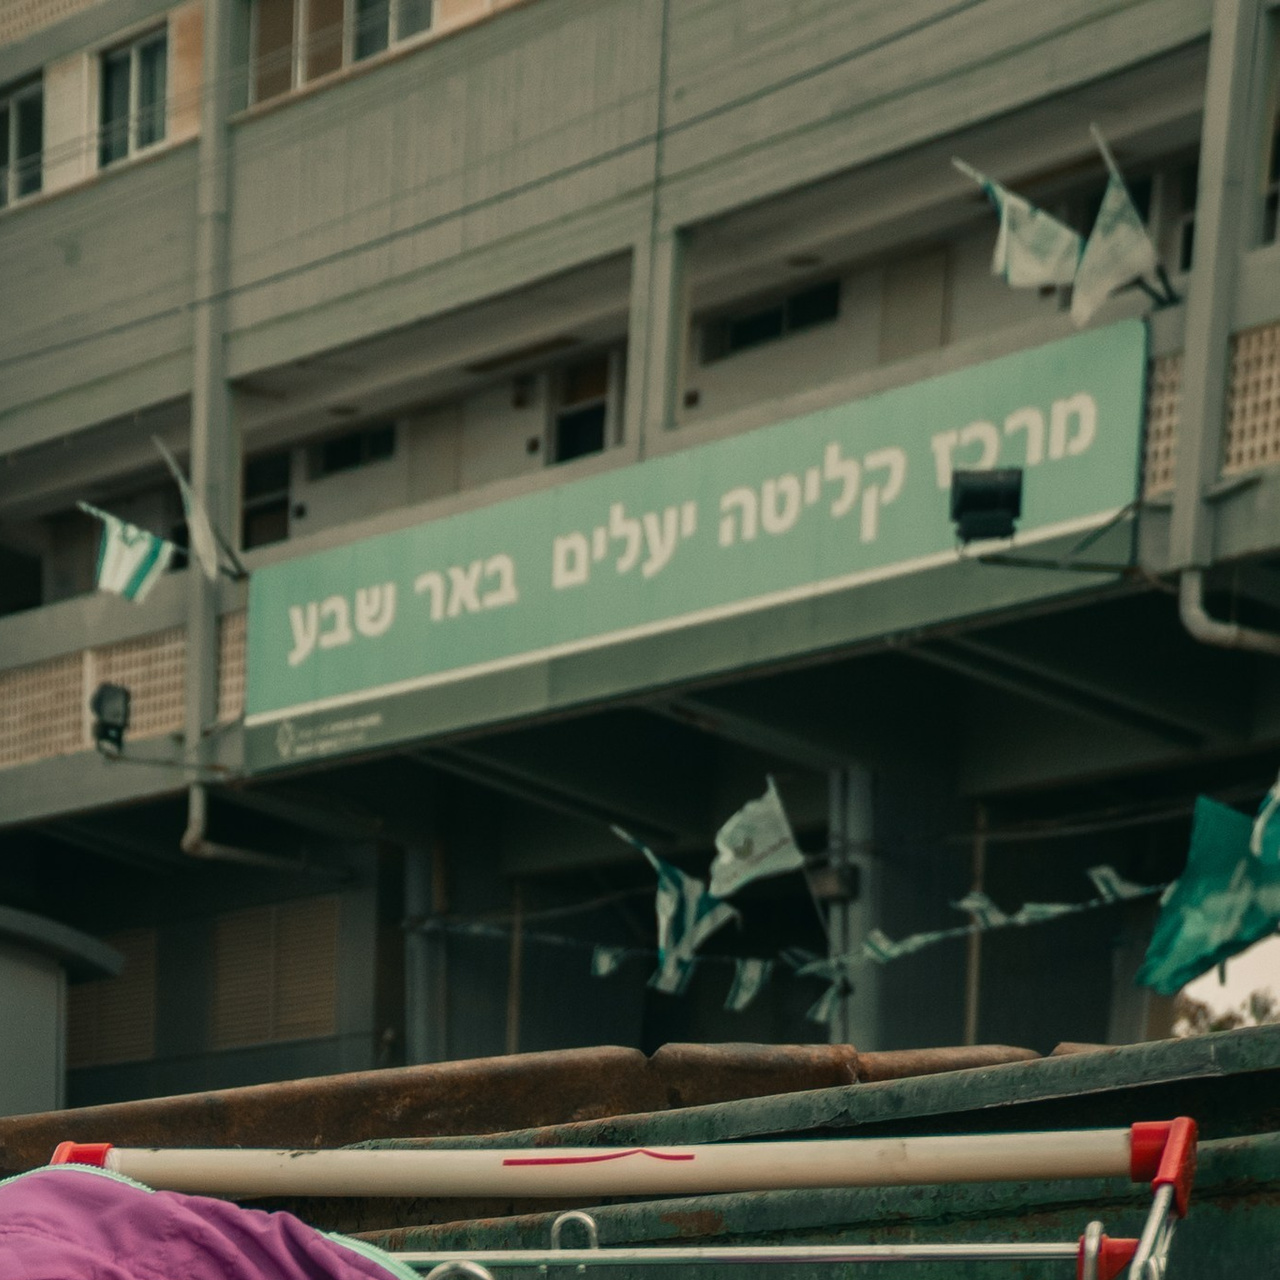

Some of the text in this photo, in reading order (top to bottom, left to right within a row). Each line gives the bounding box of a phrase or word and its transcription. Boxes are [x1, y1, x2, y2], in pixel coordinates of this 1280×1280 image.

[289, 392, 1098, 664] מרכז קליטה יעלים באר שבע
